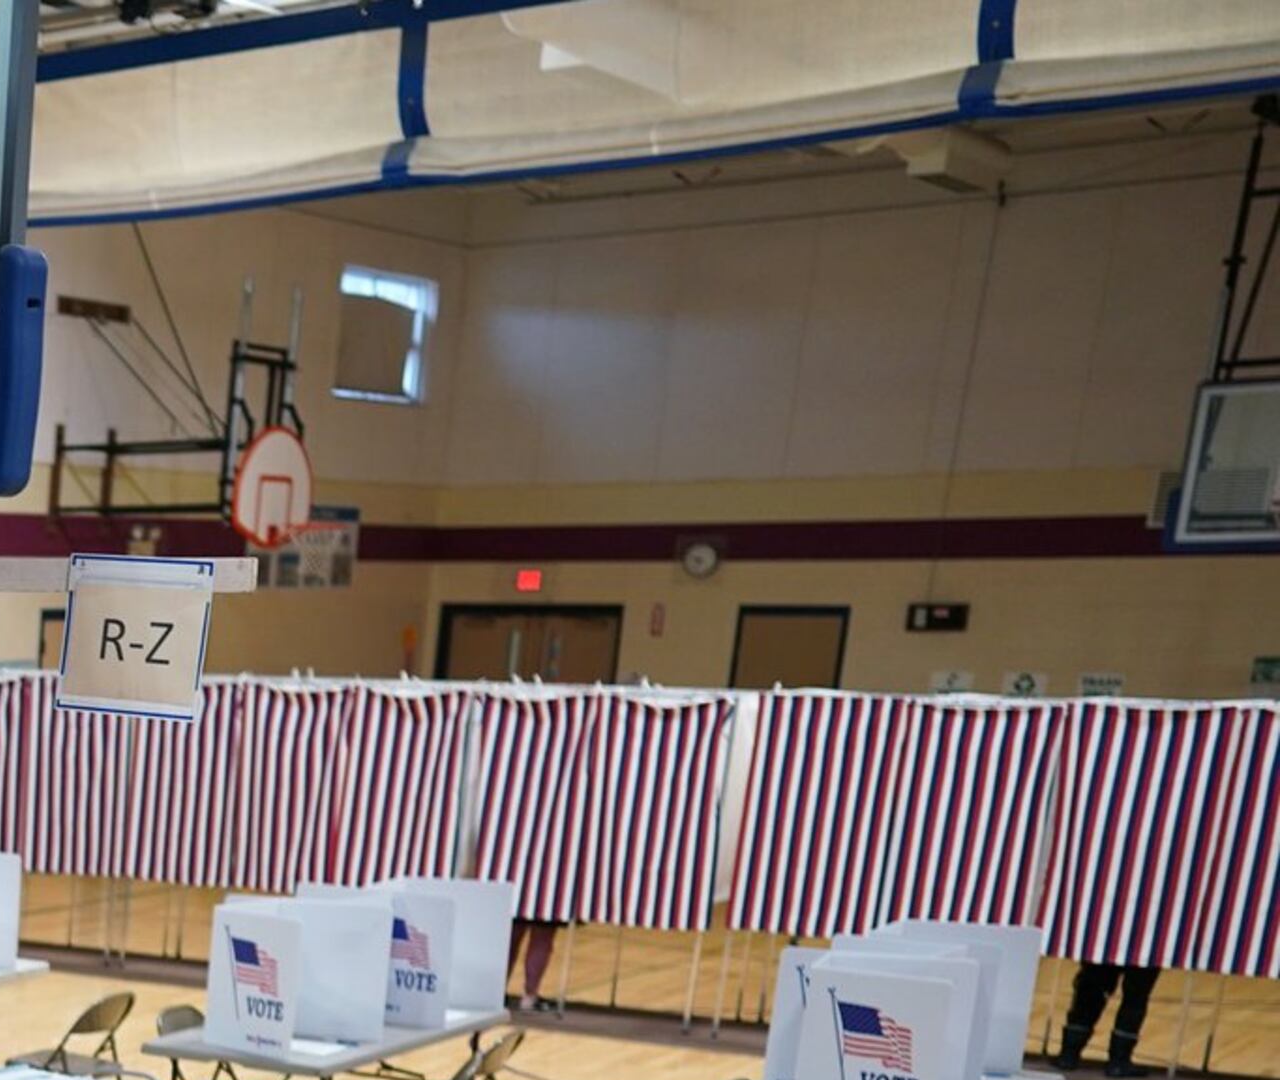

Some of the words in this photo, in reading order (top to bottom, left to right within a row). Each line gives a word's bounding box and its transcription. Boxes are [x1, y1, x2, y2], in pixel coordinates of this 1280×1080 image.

[99, 618, 175, 666] R-Z
[395, 970, 437, 993] VOTE
[246, 996, 284, 1022] VOTE
